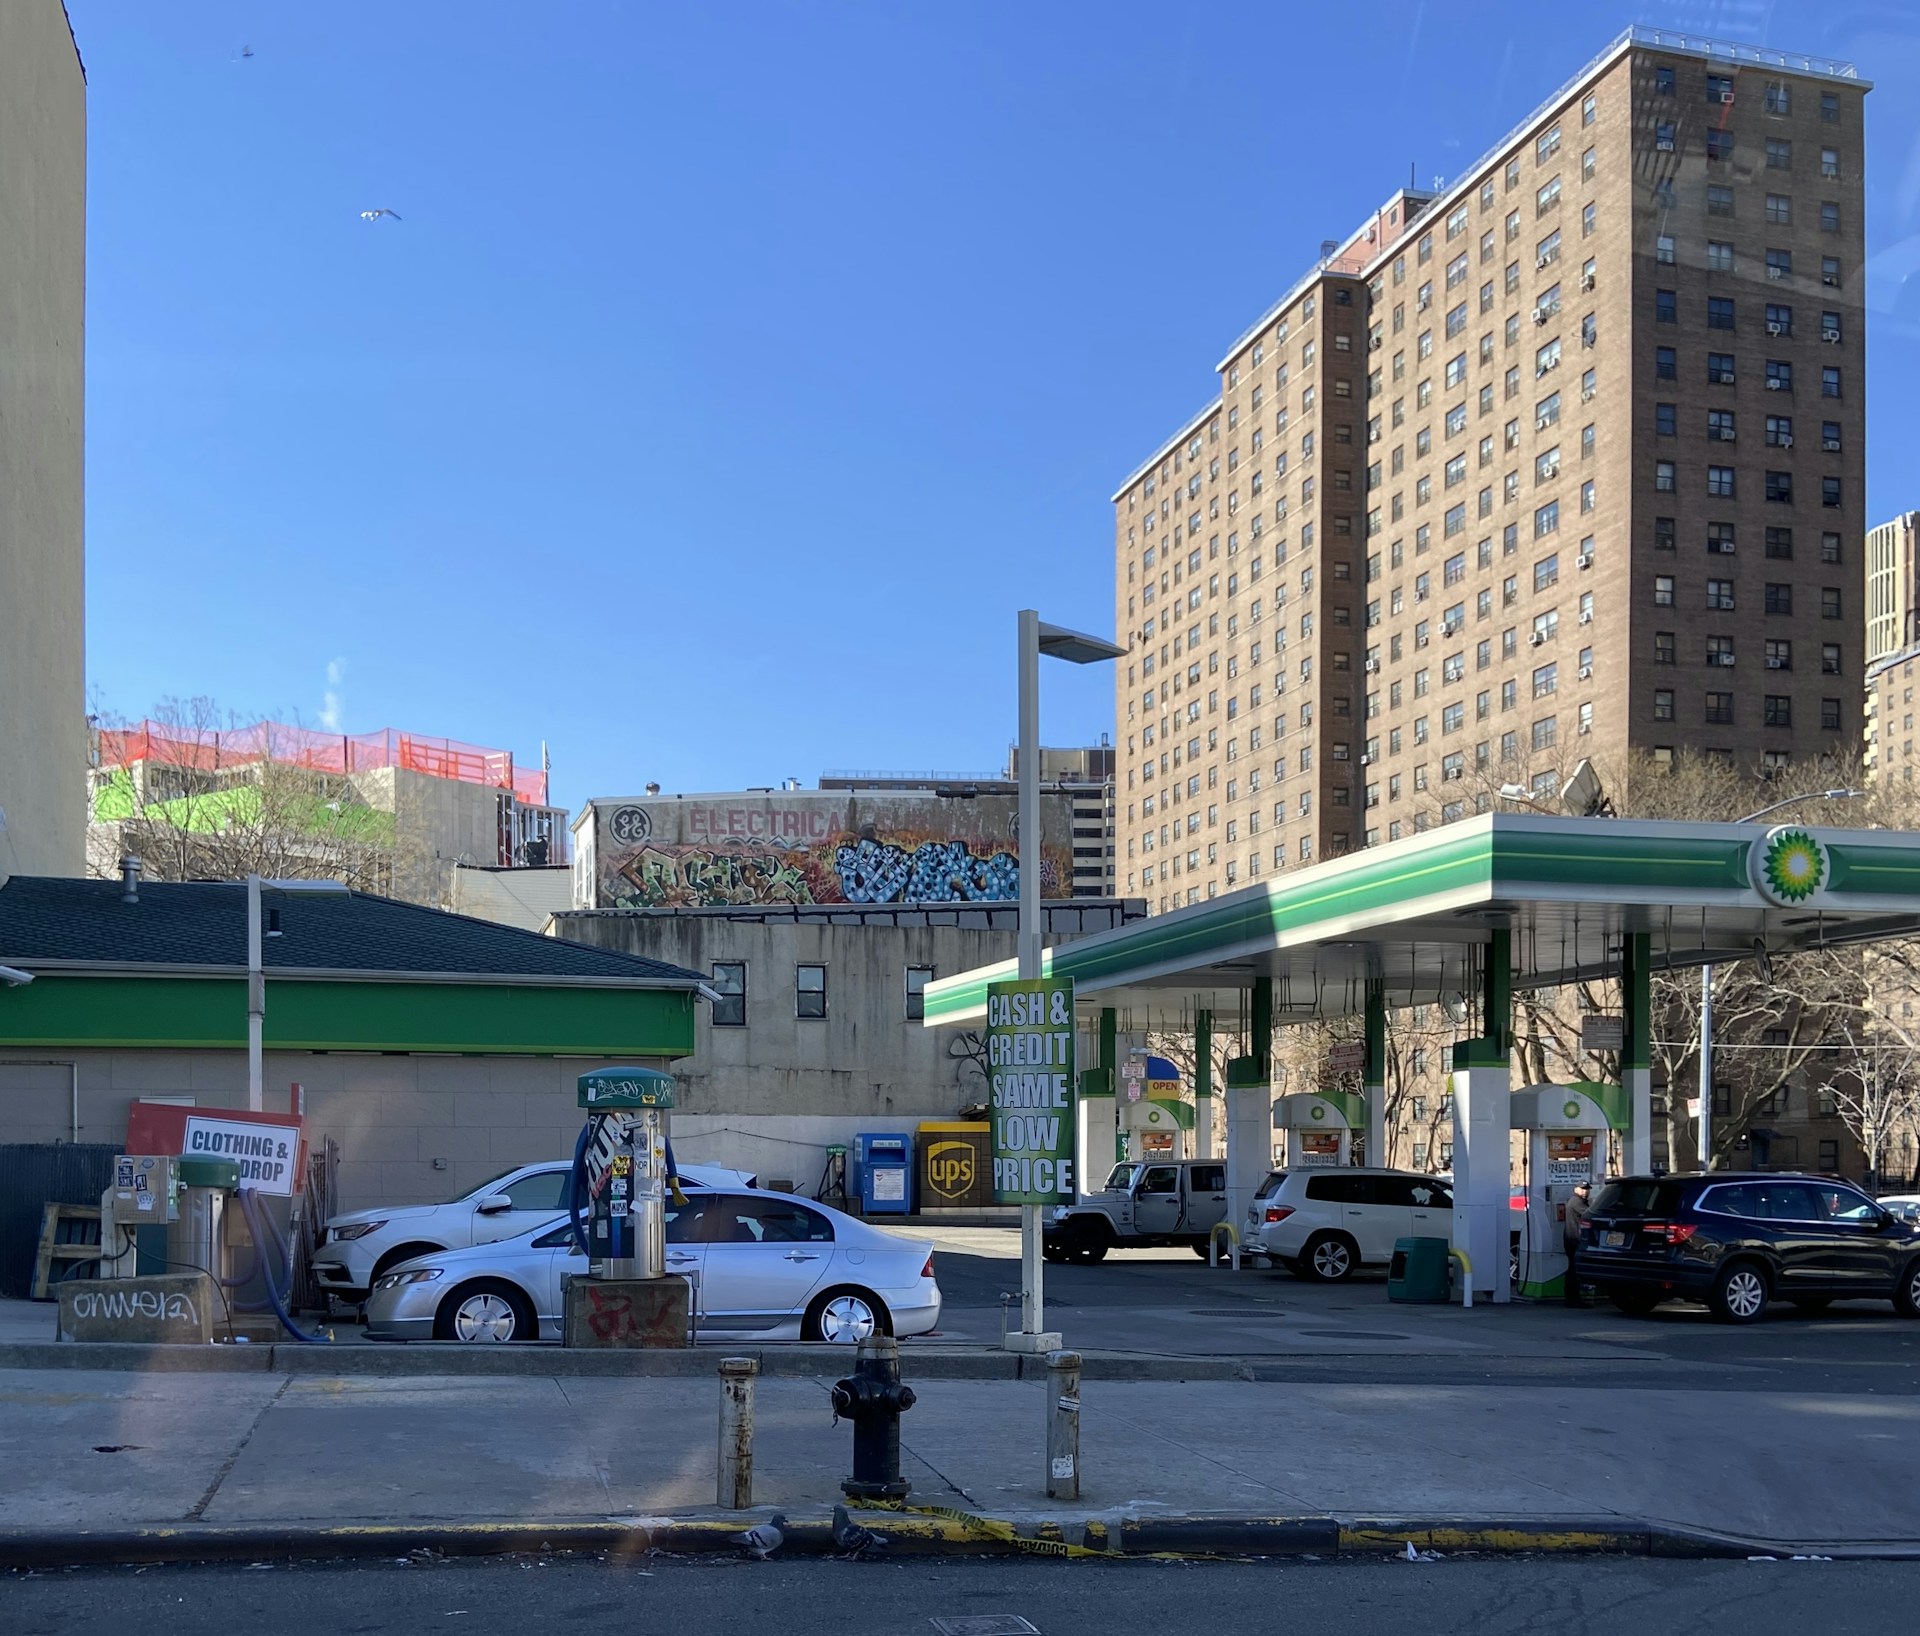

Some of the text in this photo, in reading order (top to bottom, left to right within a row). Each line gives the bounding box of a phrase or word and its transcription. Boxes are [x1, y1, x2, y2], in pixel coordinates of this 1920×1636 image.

[988, 990, 1070, 1027] CASH &
[989, 1032, 1071, 1067] CREDIT
[992, 1073, 1069, 1109] SAME
[1152, 1081, 1178, 1091] OPEN
[192, 1130, 288, 1160] CLOTHING &
[997, 1115, 1060, 1151] LOW
[240, 1158, 284, 1182] DROP
[931, 1159, 971, 1189] ups
[993, 1157, 1073, 1195] PRICE
